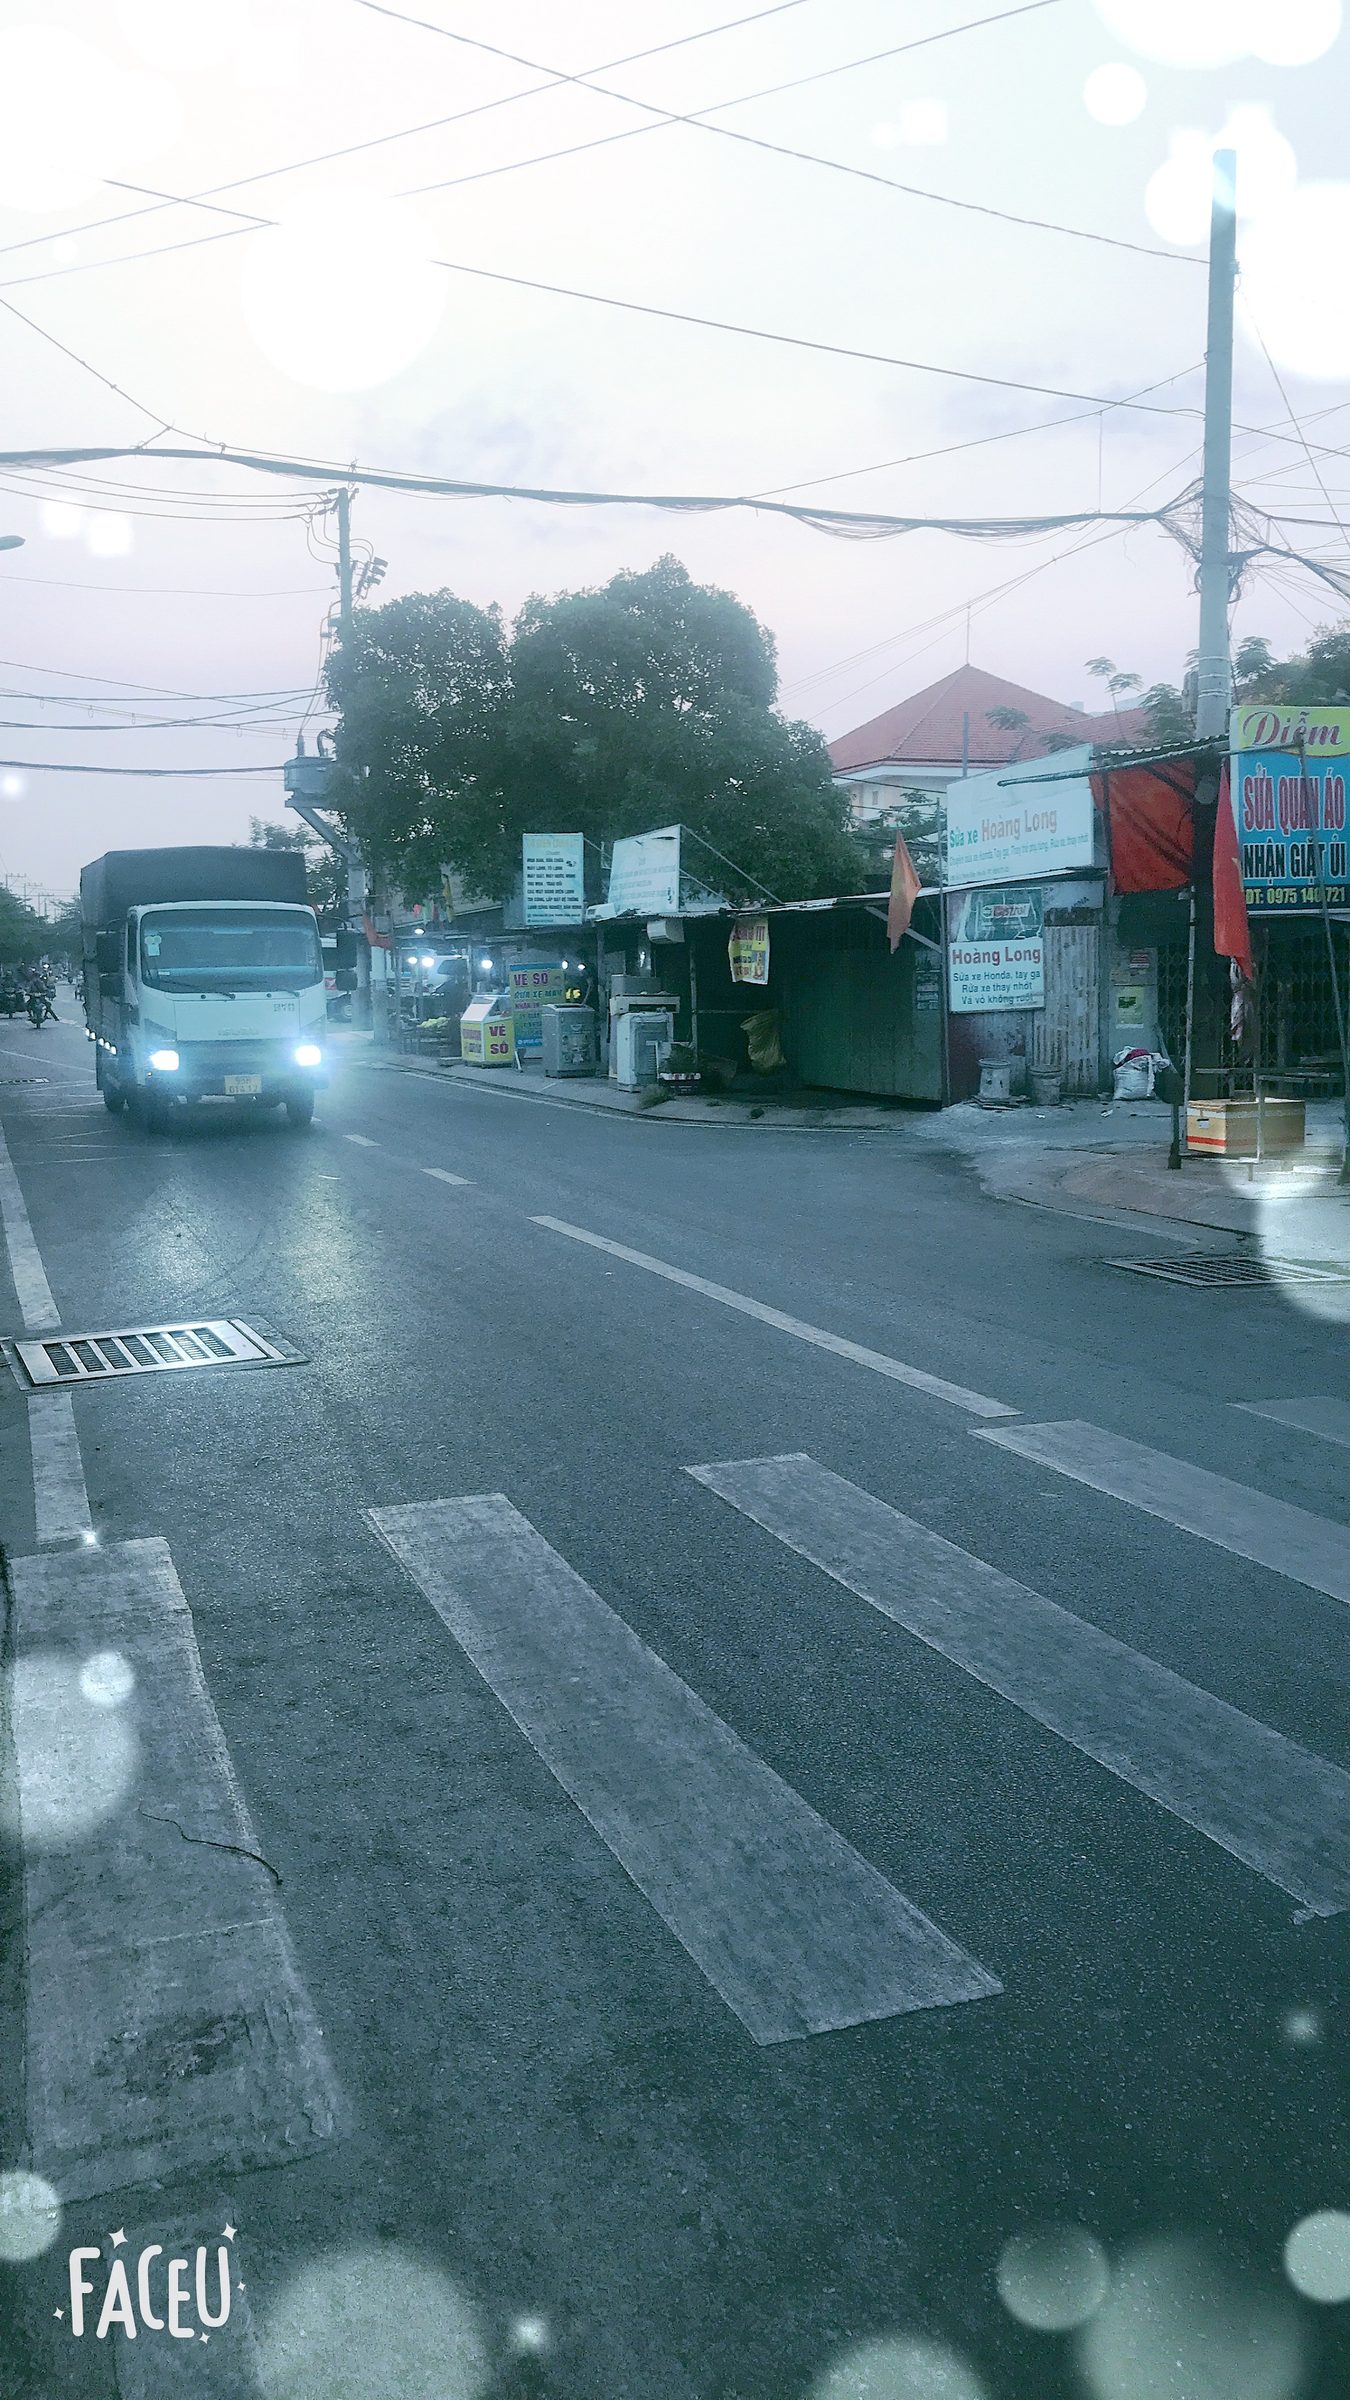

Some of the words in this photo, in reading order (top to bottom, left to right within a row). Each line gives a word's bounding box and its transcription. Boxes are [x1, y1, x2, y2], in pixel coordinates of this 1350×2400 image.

[1242, 711, 1343, 746] Diễm
[1243, 762, 1275, 831] SỬA
[1323, 767, 1345, 831] ÁO
[967, 829, 978, 844] xe
[982, 815, 1020, 841] Hoàng
[1024, 810, 1057, 833] Long
[1243, 837, 1286, 886] NHẬN
[1329, 834, 1346, 878] ỦI
[1267, 887, 1297, 904] 0975
[1326, 886, 1345, 902] 721
[952, 948, 1001, 966] Hoàng
[1004, 947, 1041, 964] Long
[513, 970, 529, 986] VÉ
[1015, 971, 1028, 980] tay
[1030, 971, 1041, 980] ga
[992, 983, 1011, 993] thay
[488, 1024, 506, 1036] VÉ
